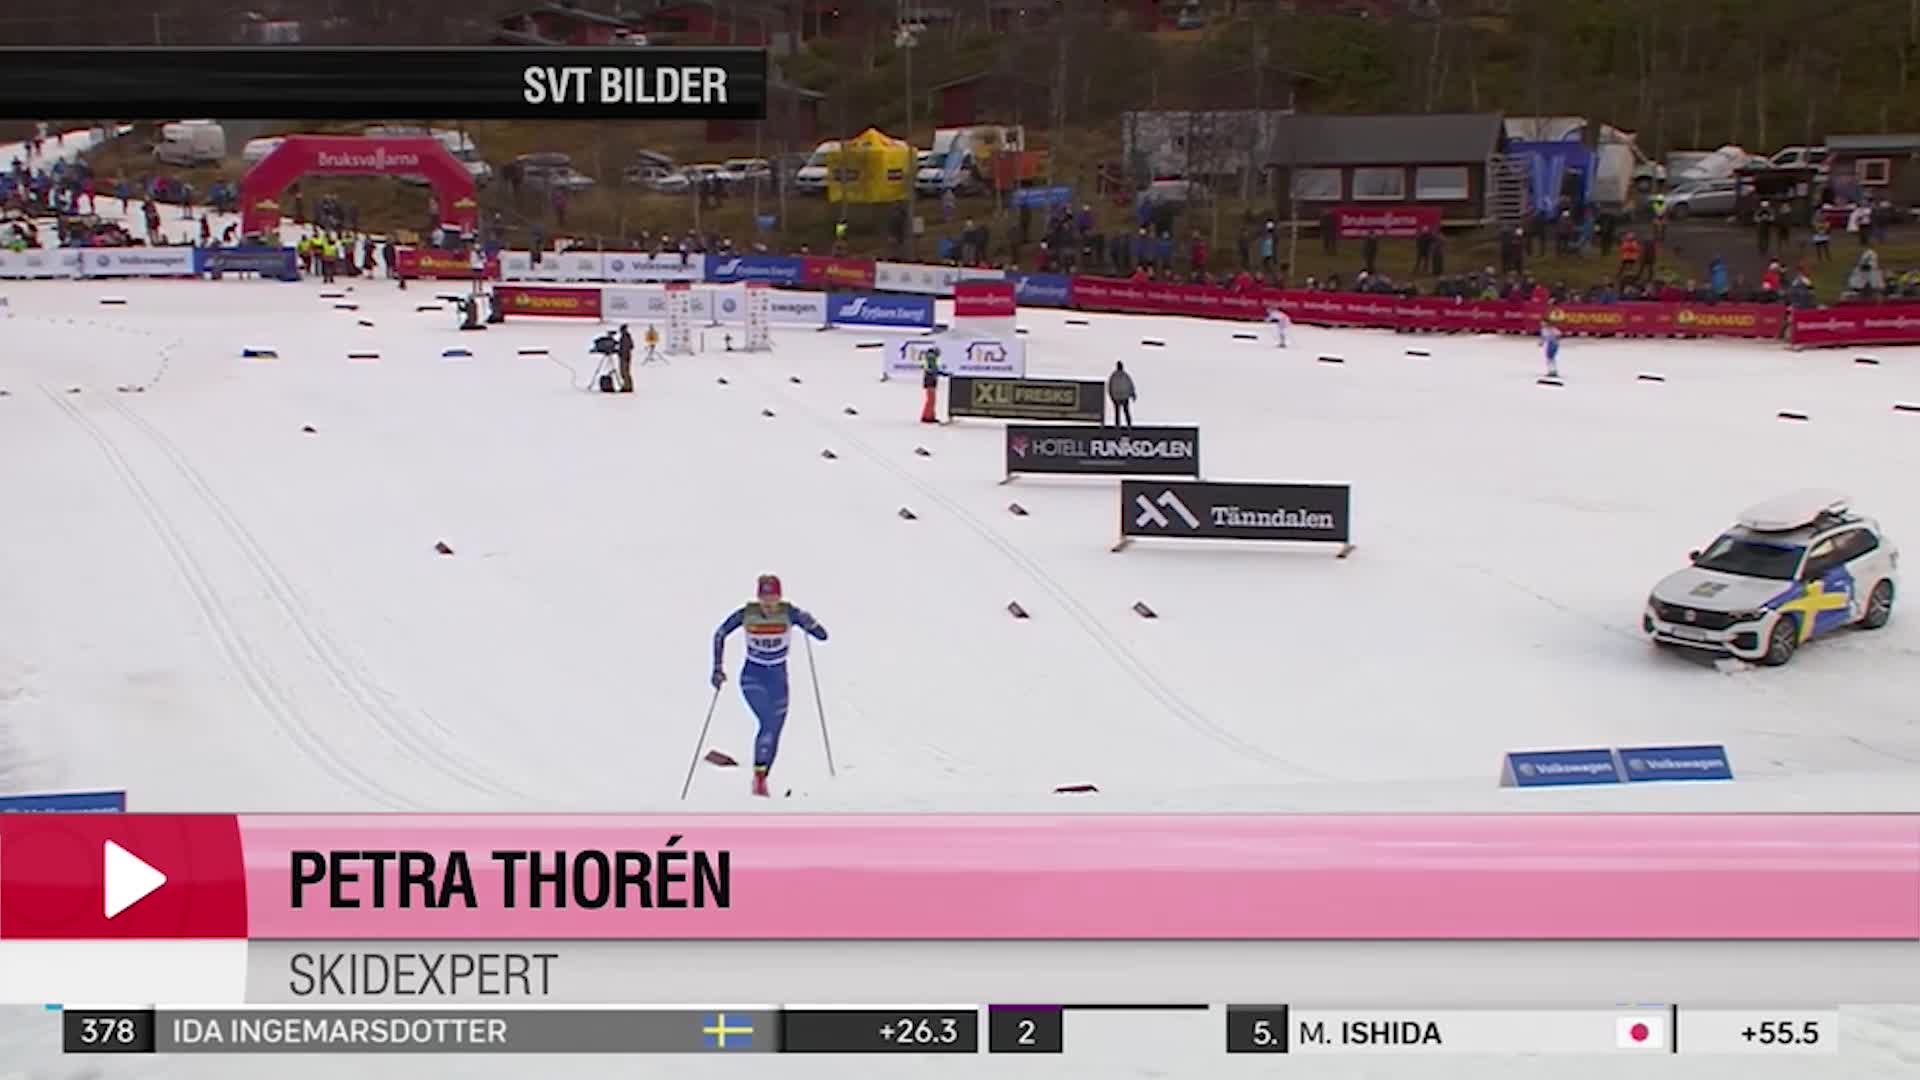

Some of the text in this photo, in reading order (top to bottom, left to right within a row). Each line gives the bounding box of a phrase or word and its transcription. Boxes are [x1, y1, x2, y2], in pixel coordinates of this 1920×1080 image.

[1032, 438, 1088, 457] HOTELL
[1210, 506, 1335, 530] Tänndalen
[1536, 761, 1613, 775] Volkswagen
[1646, 758, 1724, 771] Volkswagen
